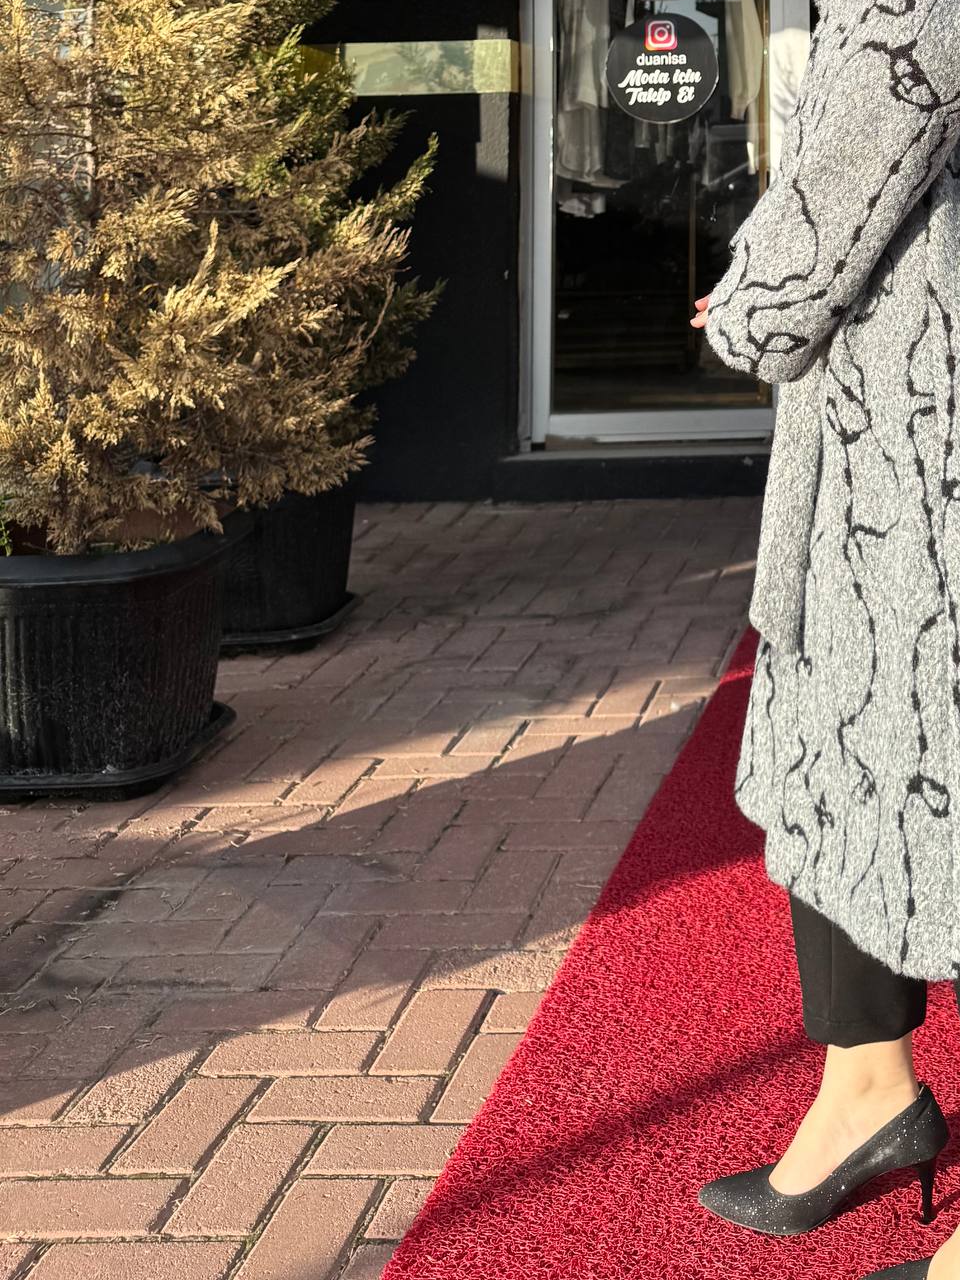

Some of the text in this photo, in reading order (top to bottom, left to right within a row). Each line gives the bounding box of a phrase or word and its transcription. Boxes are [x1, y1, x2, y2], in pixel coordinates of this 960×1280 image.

[636, 52, 686, 66] duanisa
[618, 69, 702, 88] Moda için
[625, 86, 695, 106] Takip Et
